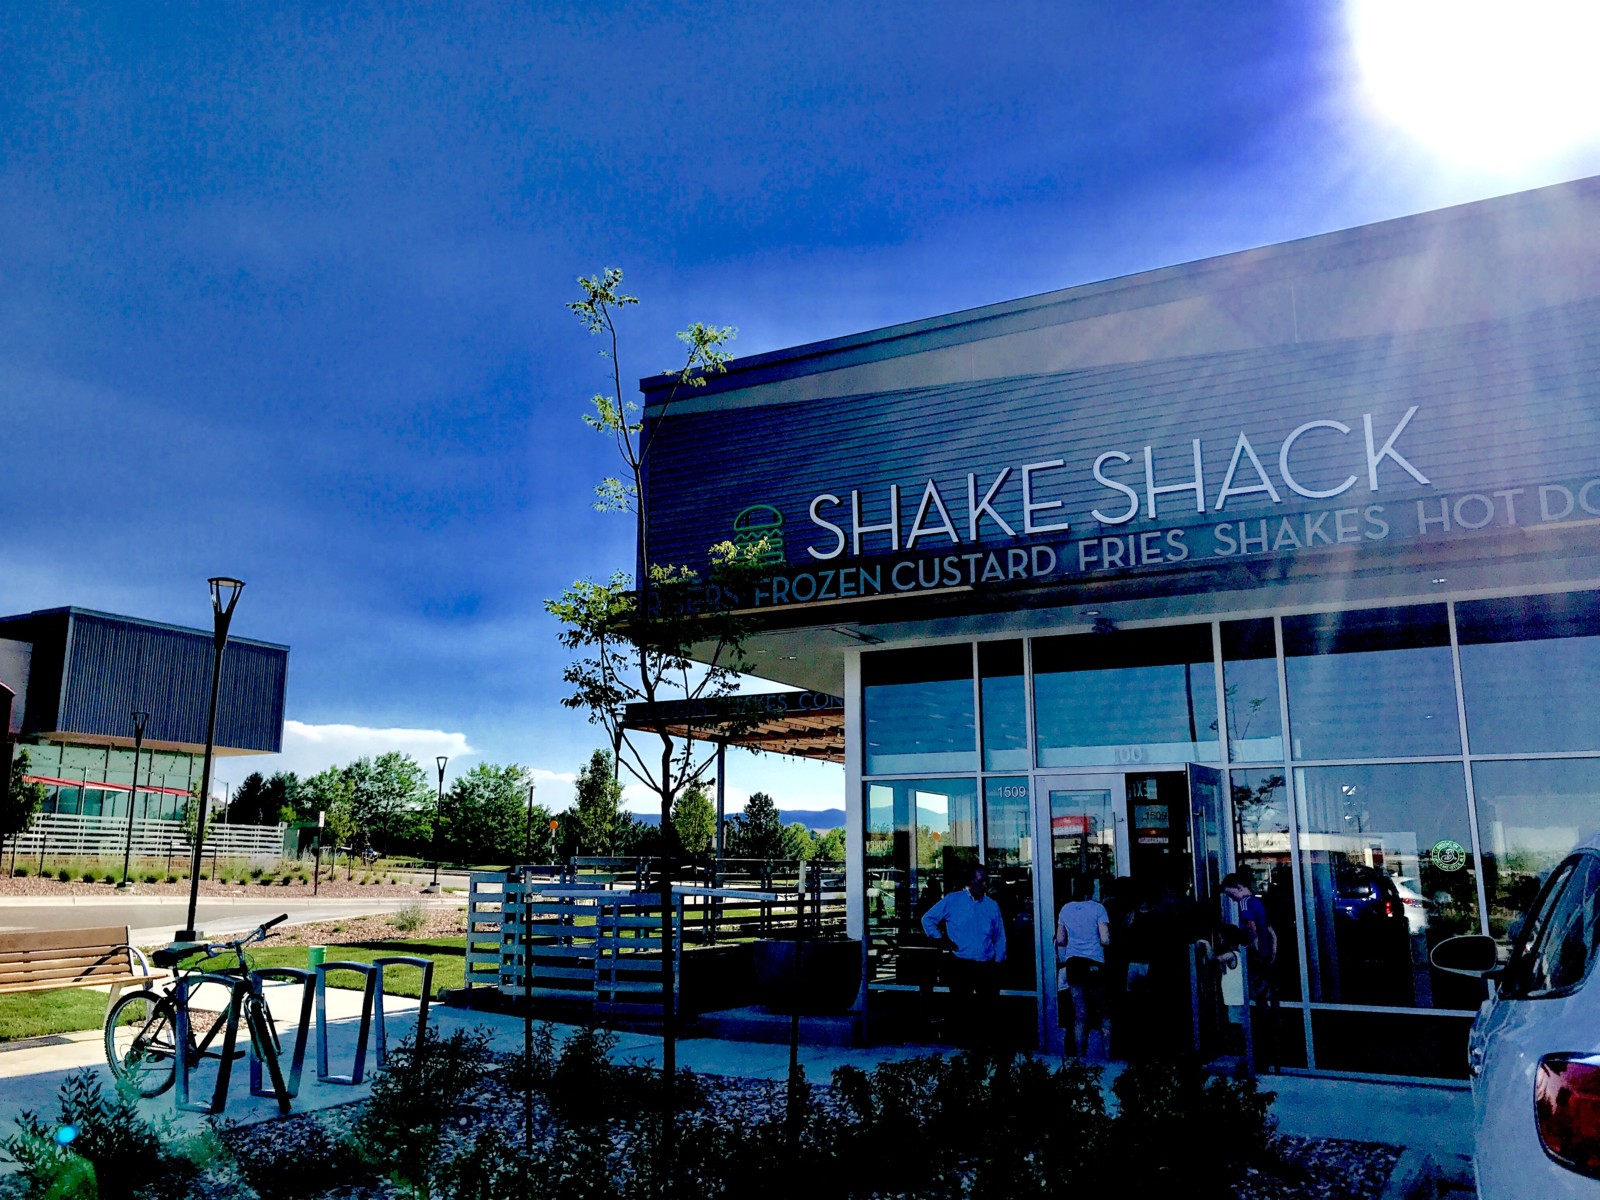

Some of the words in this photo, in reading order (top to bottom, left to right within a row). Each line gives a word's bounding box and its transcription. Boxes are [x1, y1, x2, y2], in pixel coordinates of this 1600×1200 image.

[806, 457, 1070, 561] SHAKE
[1090, 405, 1432, 526] SHACK
[754, 564, 882, 607] FROZEN
[891, 545, 1057, 592] CUSTARD
[1078, 528, 1189, 572] FRIES
[1213, 504, 1390, 556] SHAKES
[1416, 487, 1529, 535] HOT
[998, 786, 1026, 798] 1509
